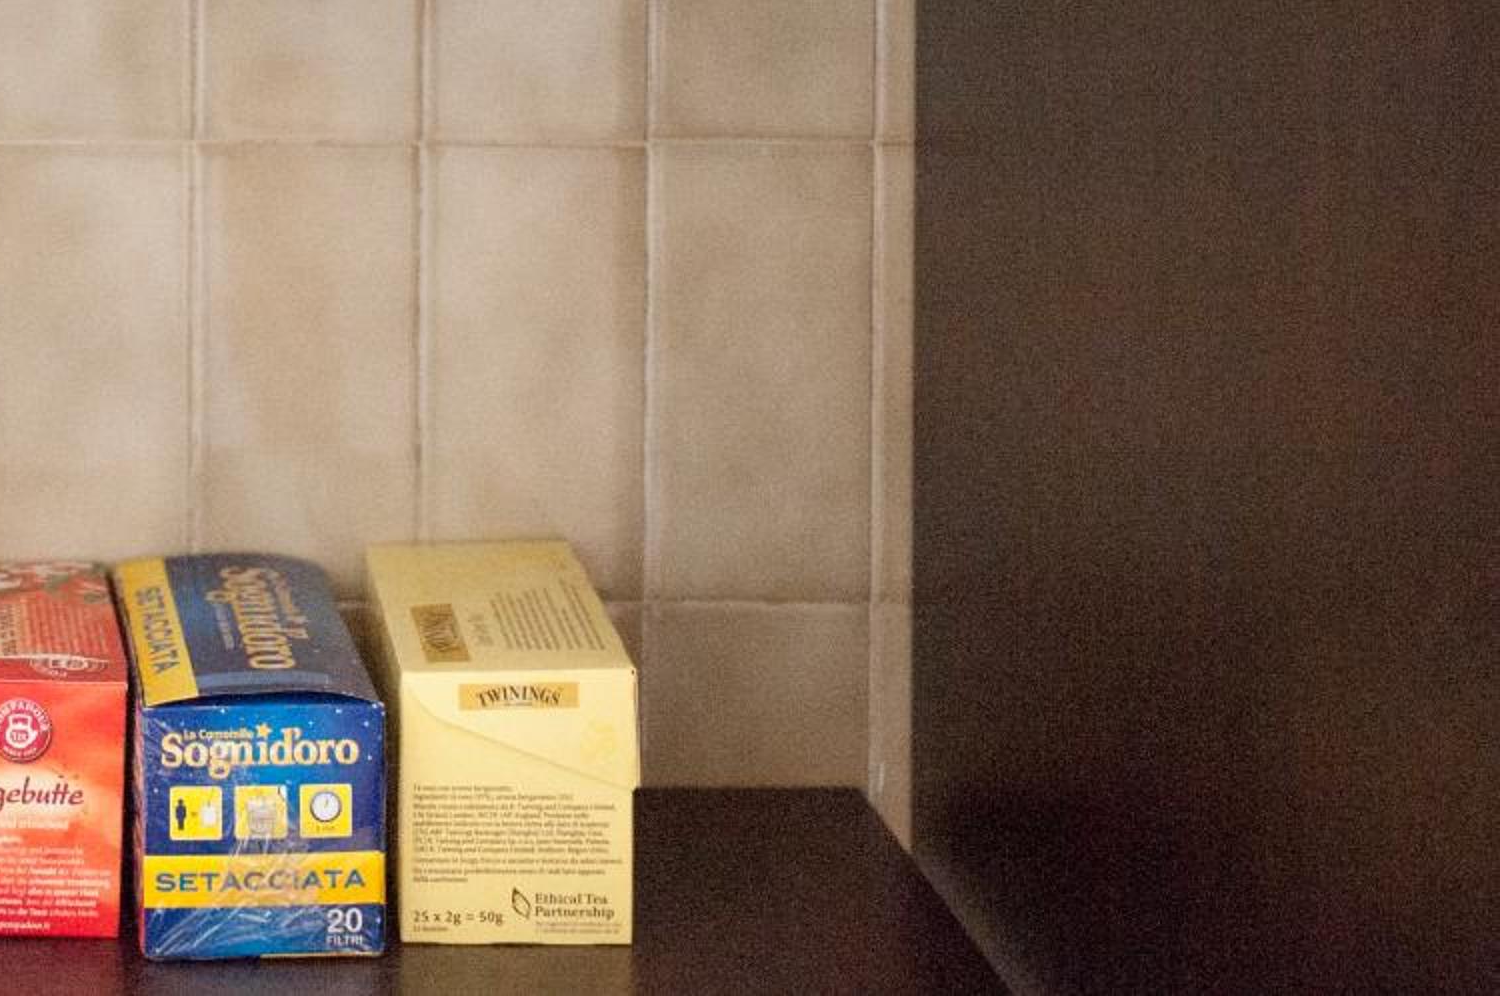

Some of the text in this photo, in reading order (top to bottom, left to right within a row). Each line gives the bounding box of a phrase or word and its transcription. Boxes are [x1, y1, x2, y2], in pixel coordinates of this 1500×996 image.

[476, 685, 561, 707] TWININGS
[156, 869, 366, 892] SETACCIATA
[535, 892, 609, 905] Ethical Tea
[326, 908, 363, 933] 20
[413, 910, 429, 923] 25
[446, 910, 461, 926] 2g
[479, 910, 504, 926] 50g
[535, 906, 615, 921] Partnership
[326, 934, 363, 946] FILTRI
